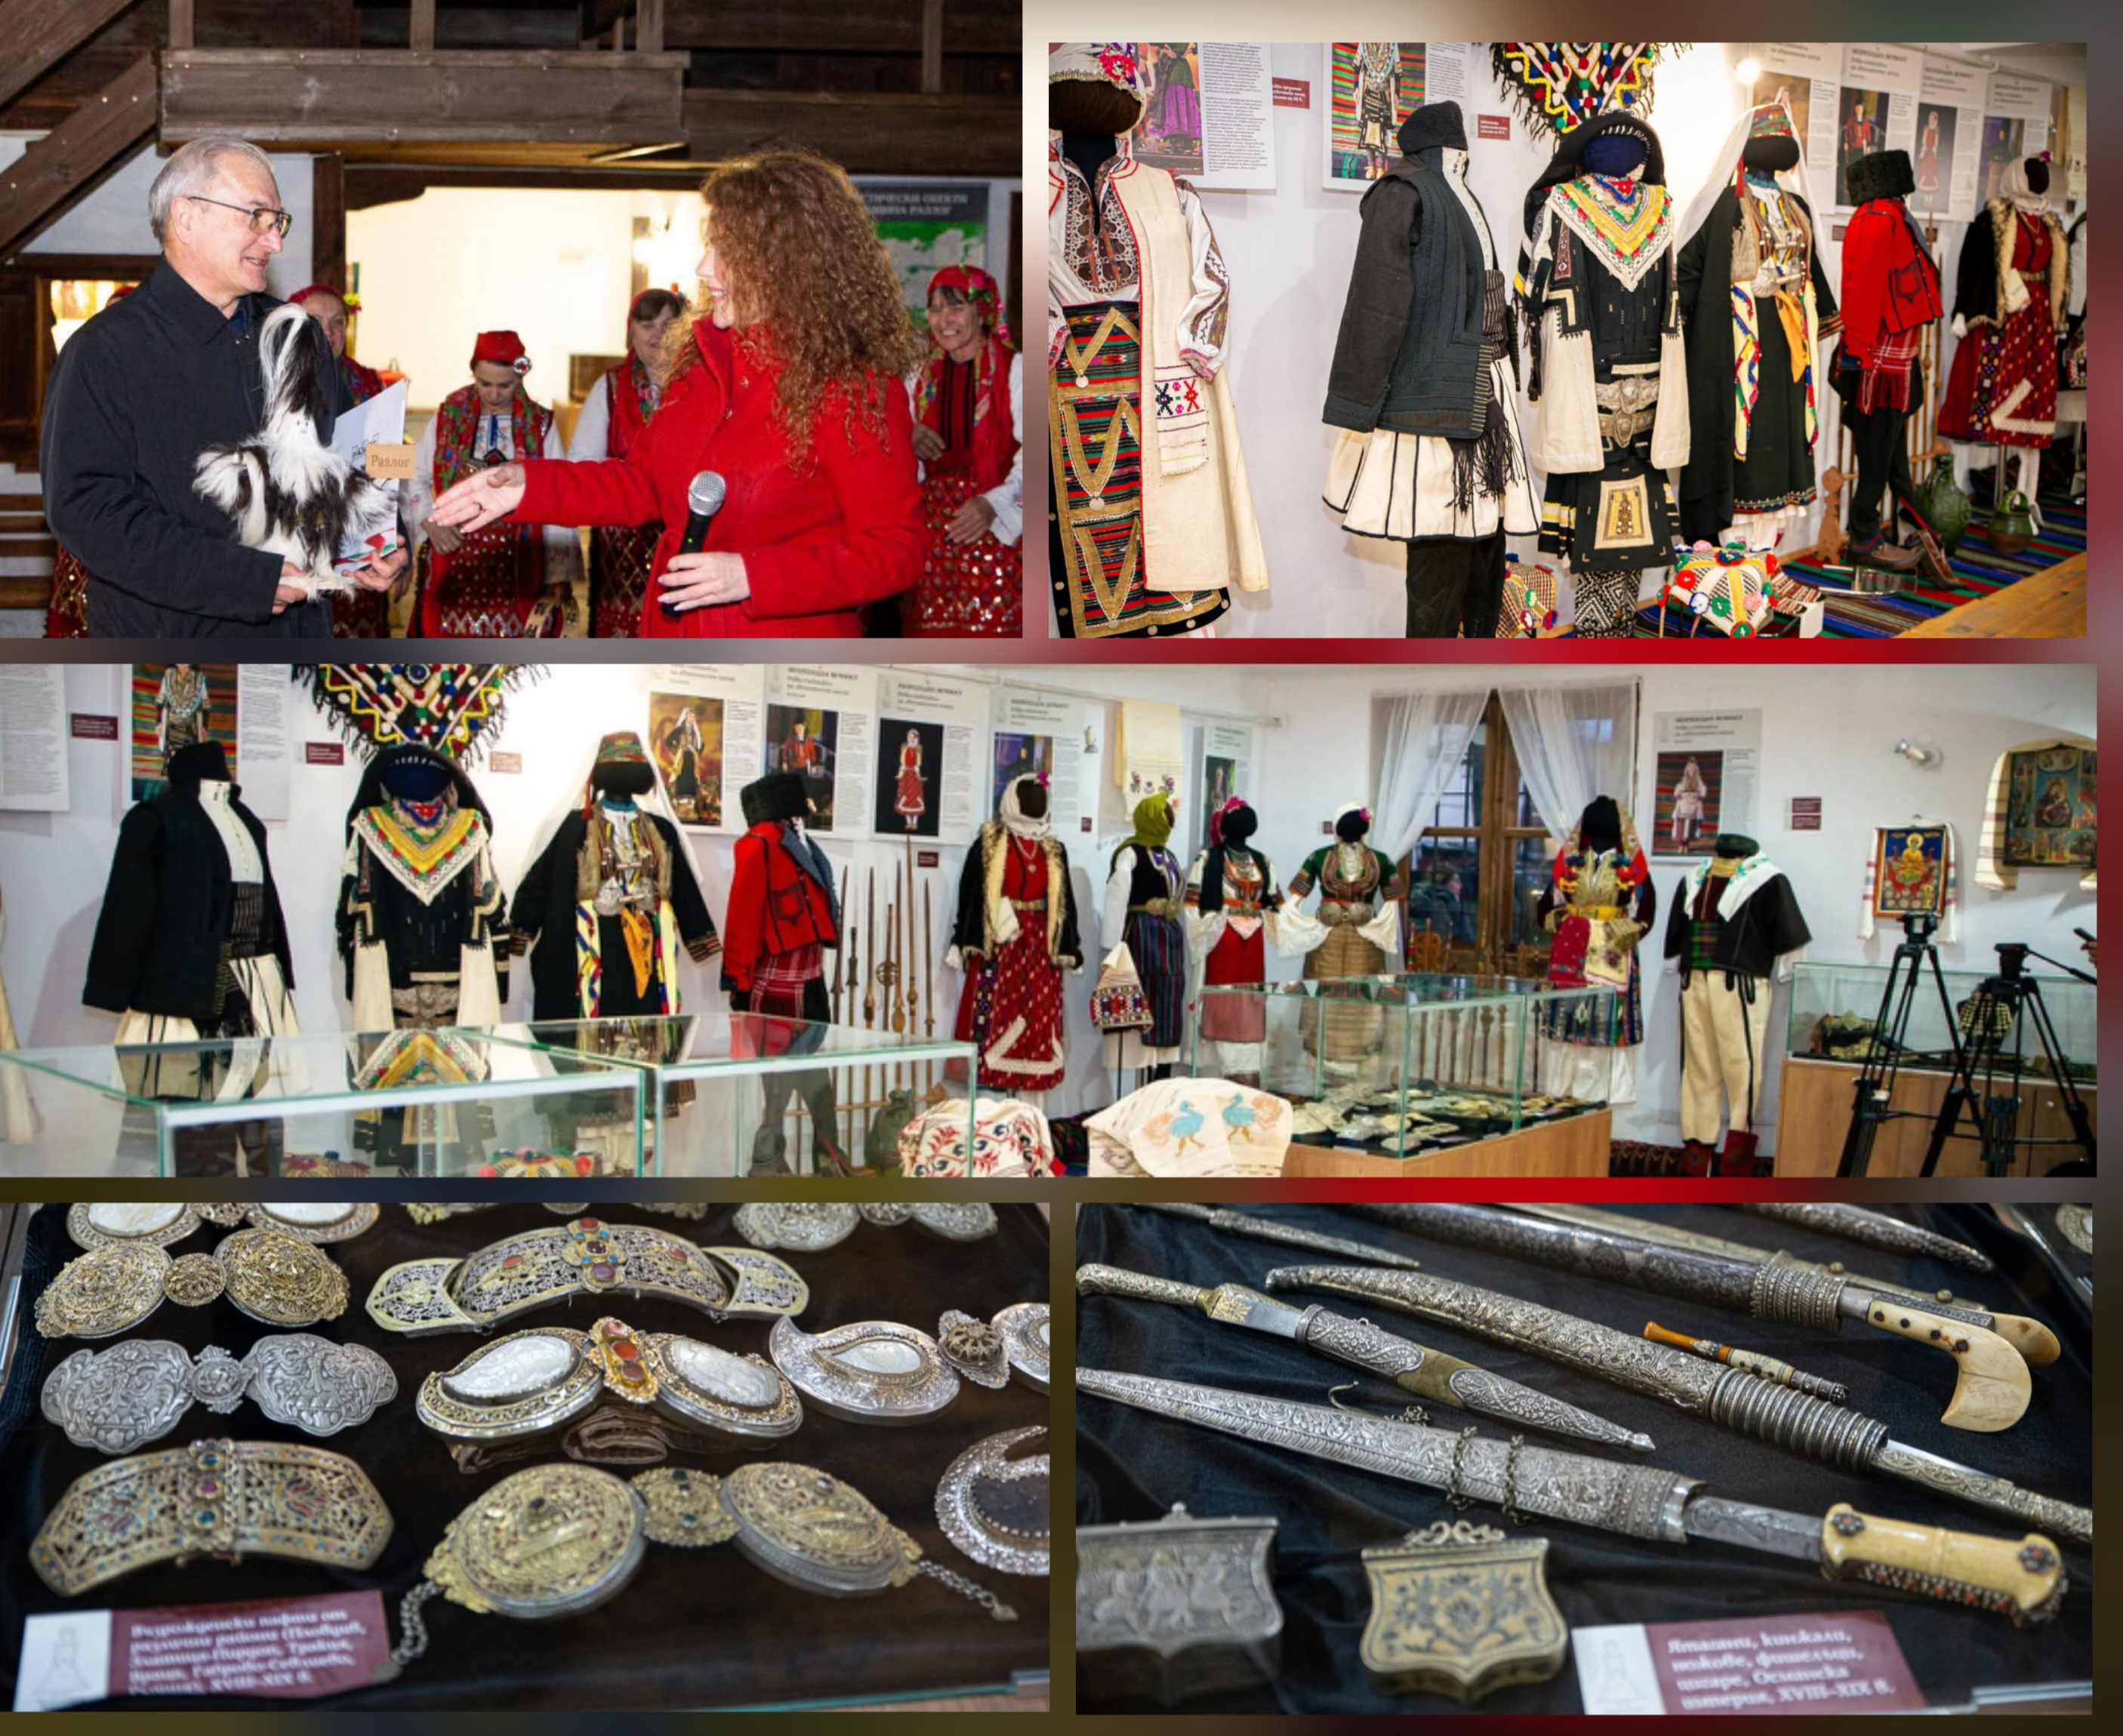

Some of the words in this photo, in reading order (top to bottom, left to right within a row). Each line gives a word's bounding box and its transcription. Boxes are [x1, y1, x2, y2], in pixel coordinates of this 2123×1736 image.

[371, 454, 411, 468] Разлог
[1667, 1636, 1758, 1654] Ятагани,
[1759, 1628, 1853, 1647] кинжали,
[1671, 1651, 1754, 1673] ножове,
[1752, 1664, 1851, 1685] Османска
[1681, 1690, 1776, 1710] империя,
[1872, 1677, 1897, 1695] в.
